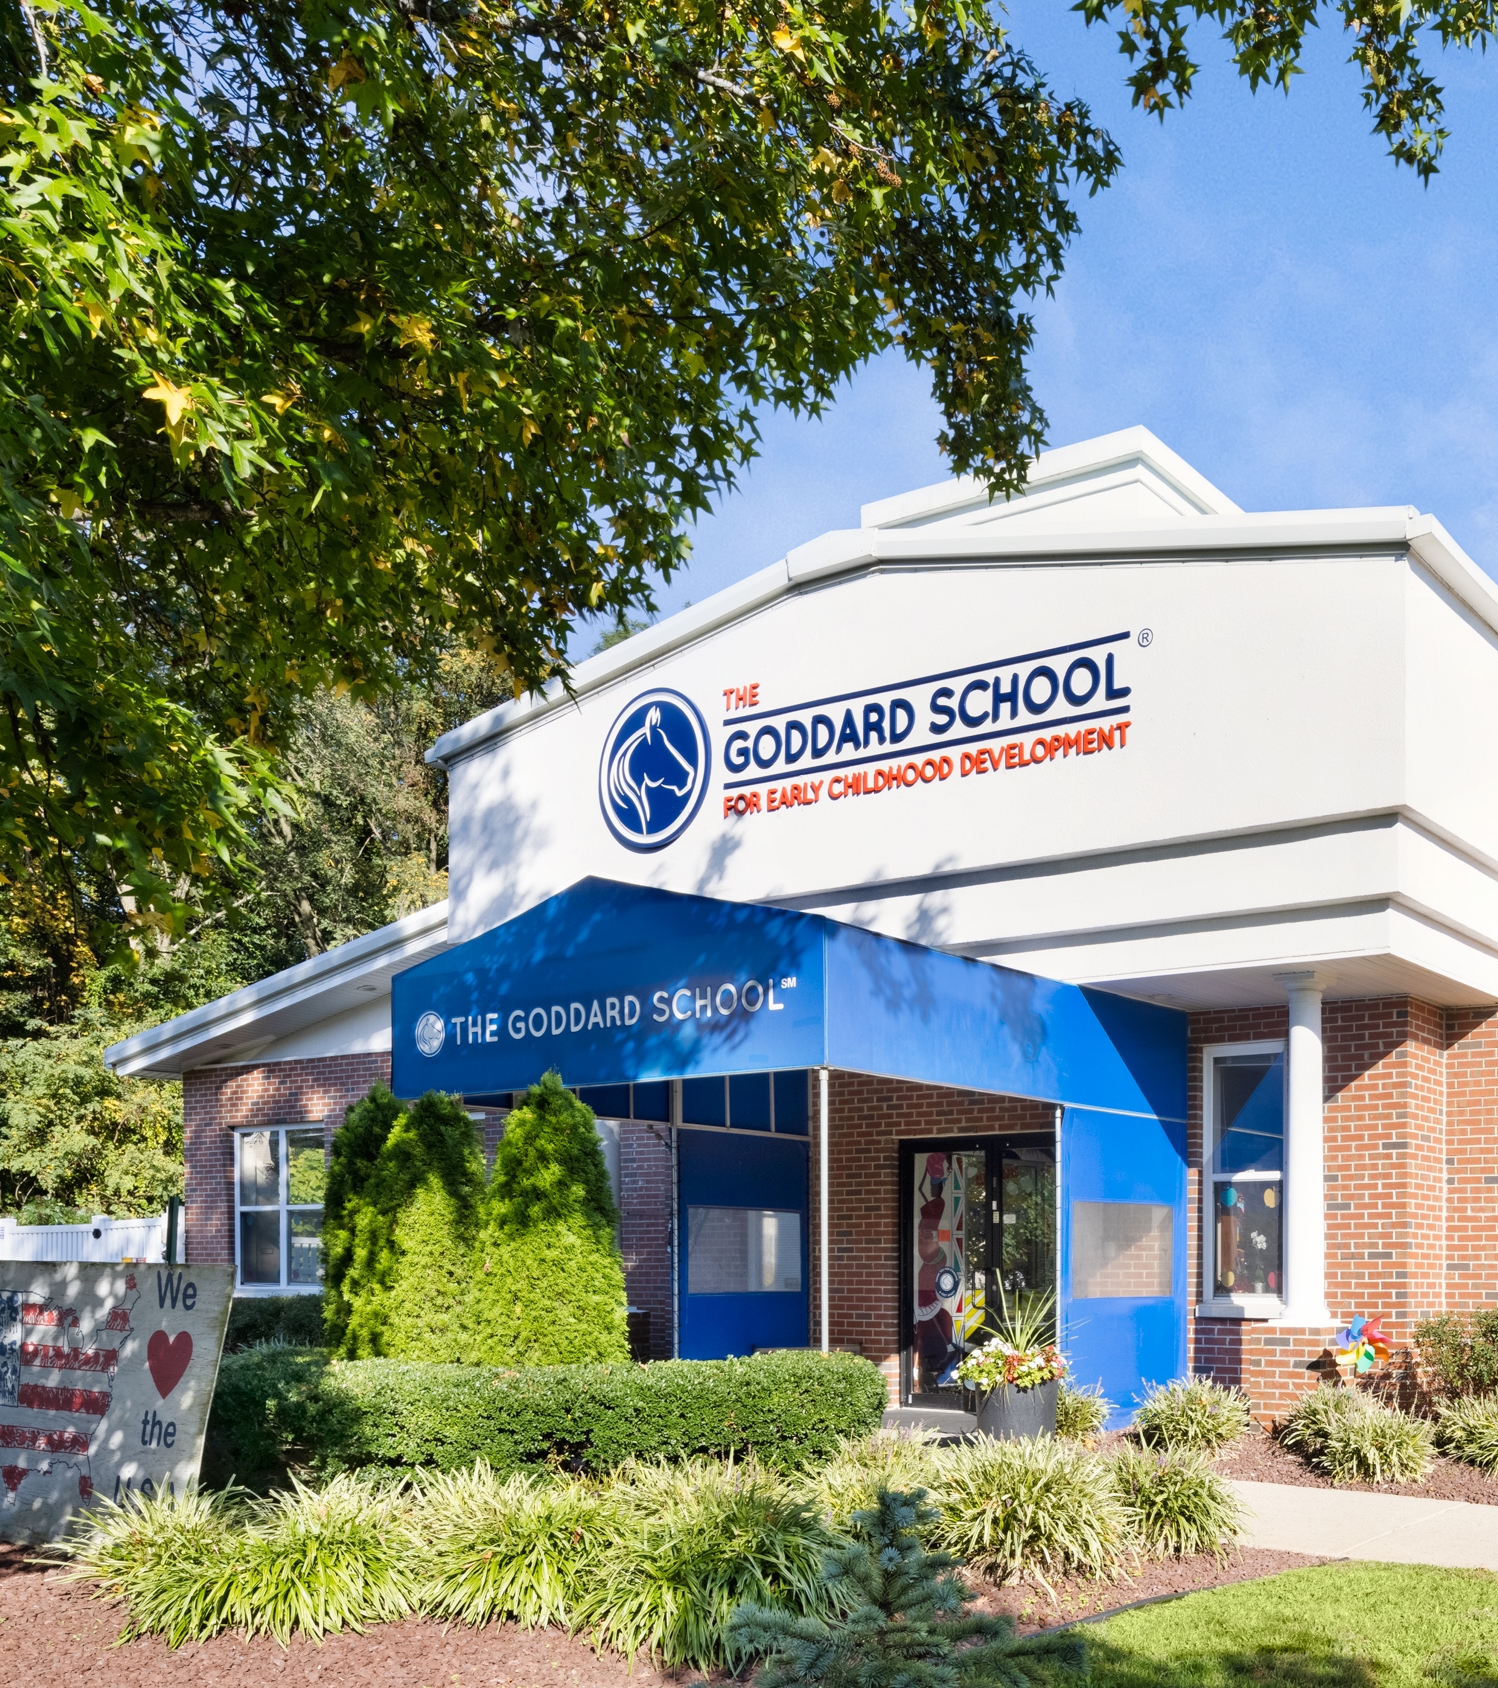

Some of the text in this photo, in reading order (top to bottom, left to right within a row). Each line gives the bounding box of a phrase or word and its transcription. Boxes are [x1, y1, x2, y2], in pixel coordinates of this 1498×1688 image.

[723, 683, 760, 712] THE
[724, 698, 916, 774] GODDARD
[929, 652, 1132, 735] SCHOOL
[723, 721, 1132, 819] FOR EARLY CHILDHOOD DEVELOPMENT
[451, 1013, 498, 1045] THE
[508, 995, 641, 1040] GODDARD
[653, 978, 784, 1023] SCHOOL
[157, 1270, 198, 1311] We
[141, 1410, 177, 1448] the
